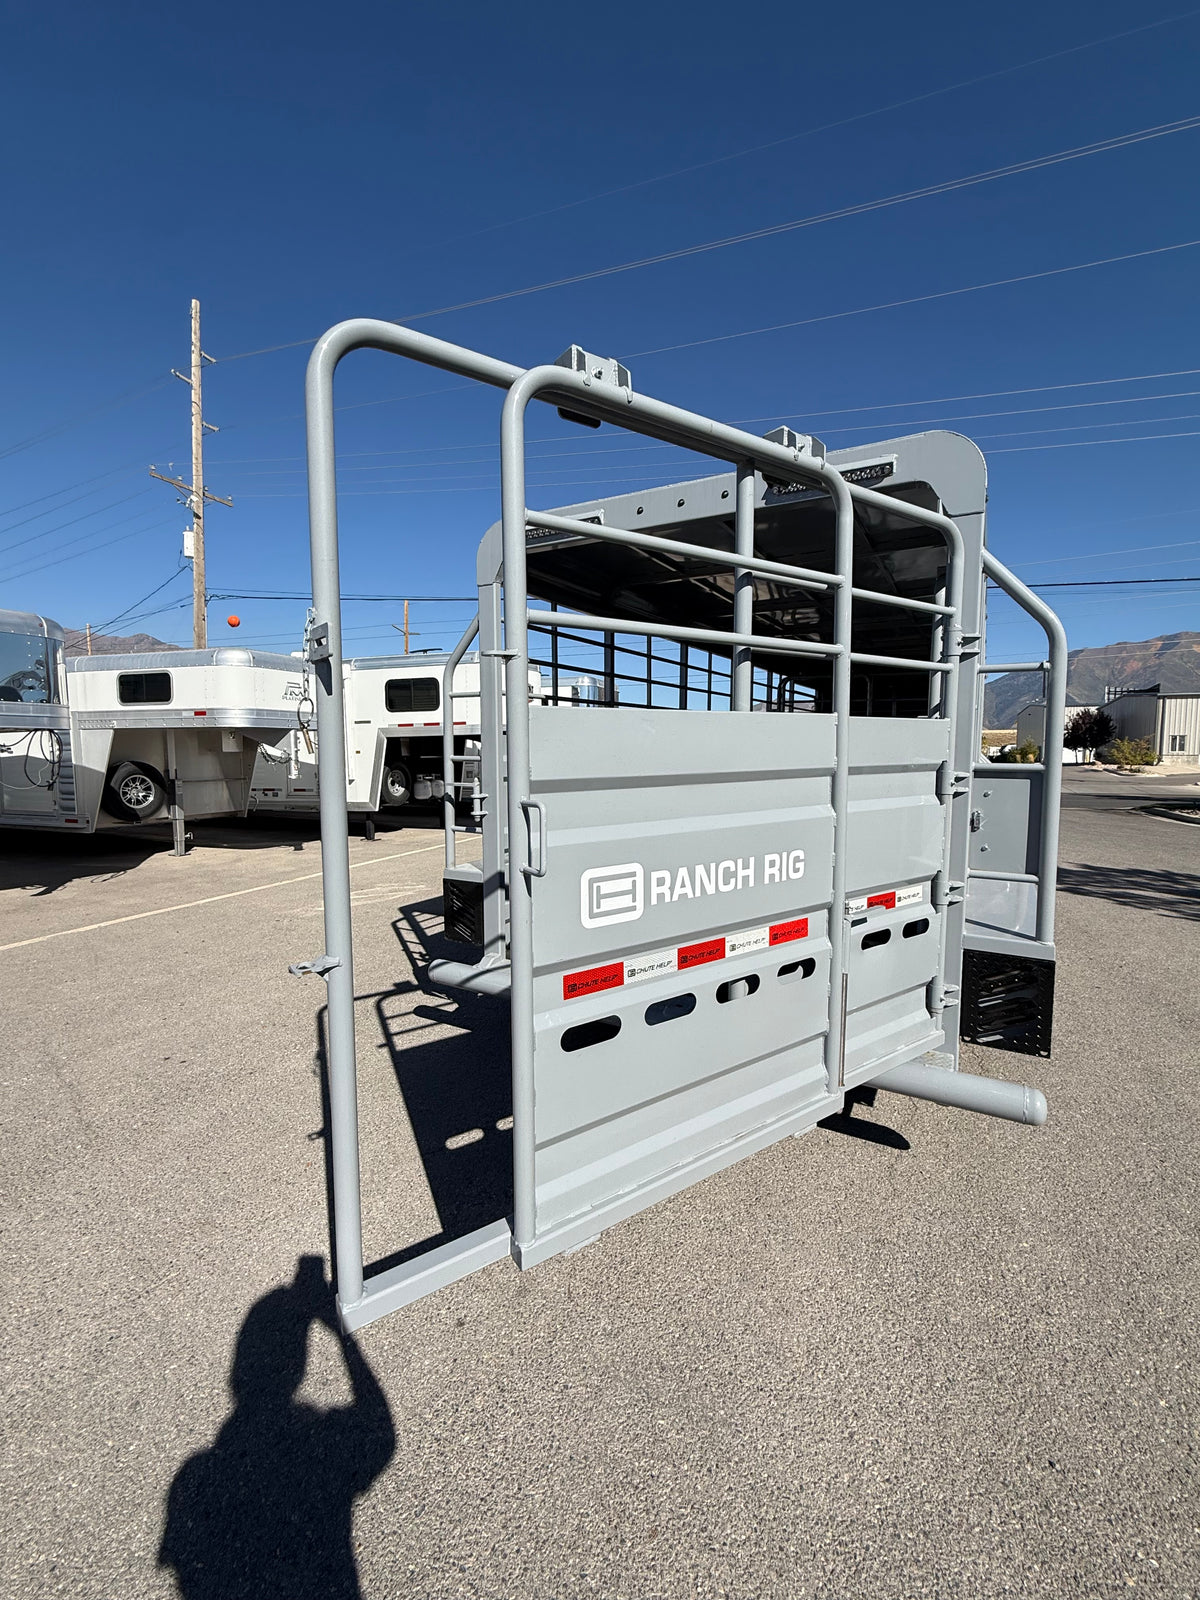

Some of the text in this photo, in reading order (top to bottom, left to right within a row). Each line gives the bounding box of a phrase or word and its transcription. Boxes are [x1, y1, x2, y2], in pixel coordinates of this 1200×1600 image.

[650, 849, 805, 906] RANCH RIG
[752, 937, 766, 946] HELP
[688, 948, 720, 961] CHUTE HELP
[637, 964, 655, 974] CHUTE
[655, 960, 673, 969] HELP
[578, 974, 619, 989] CHUTE HELP
